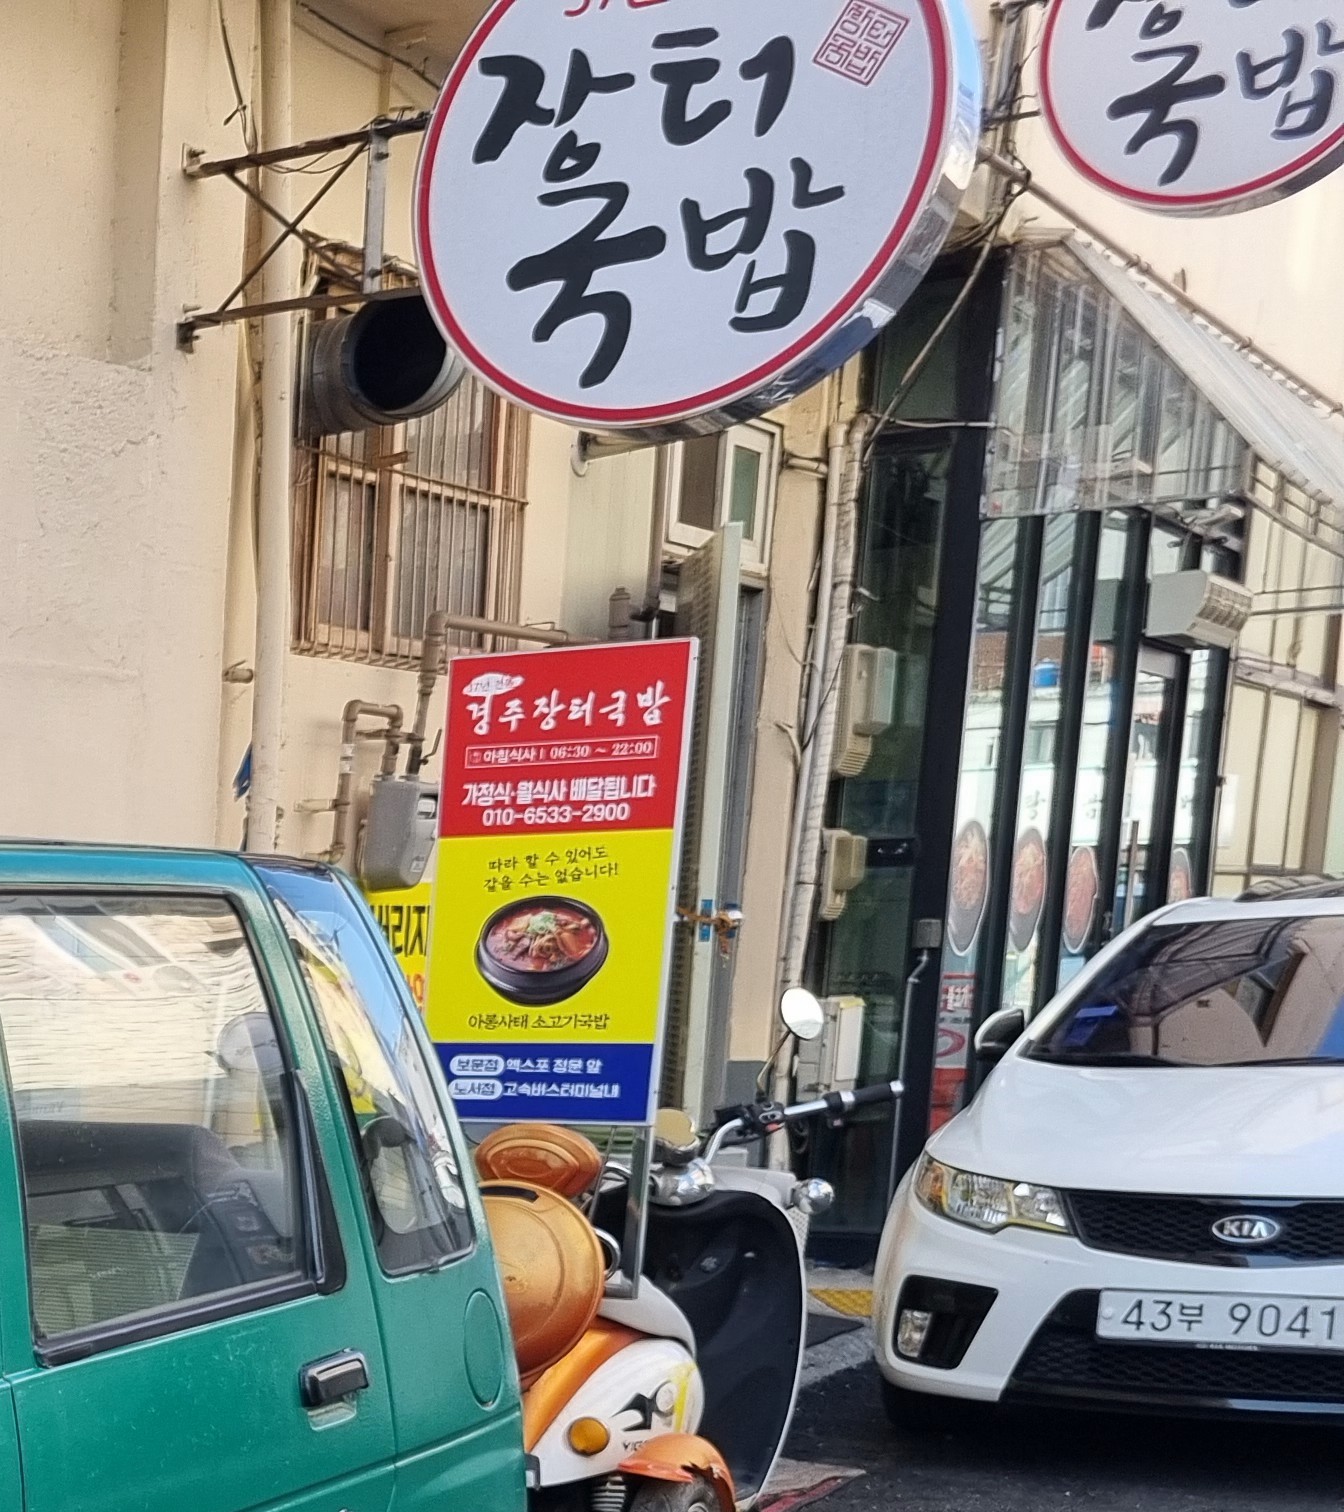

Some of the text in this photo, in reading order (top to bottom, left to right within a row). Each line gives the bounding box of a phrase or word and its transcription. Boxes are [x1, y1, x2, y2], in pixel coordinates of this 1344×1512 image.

[473, 27, 795, 184] 장터
[1106, 19, 1344, 187] 국밥
[505, 156, 846, 390] 국밥
[466, 680, 672, 735] 경주장터국밥
[483, 747, 537, 763] 아침식사
[550, 744, 590, 759] 06:30
[611, 741, 652, 756] 22:00
[570, 774, 656, 802] 배달됩니다
[482, 803, 630, 827] 010-6533-2900
[488, 856, 519, 872] 따라
[545, 851, 560, 866] 수
[565, 846, 608, 864] 있어도
[519, 872, 550, 887] 수는
[554, 862, 618, 884] 없습니다!
[531, 1013, 610, 1030] 소고기국밥
[456, 1057, 603, 1074] 보문점 엑스포 정문 앞
[454, 1082, 620, 1099] 노서점 고속버스터미널내
[1222, 1221, 1268, 1238] KIA
[1120, 1299, 1337, 1340] 43부 9041
